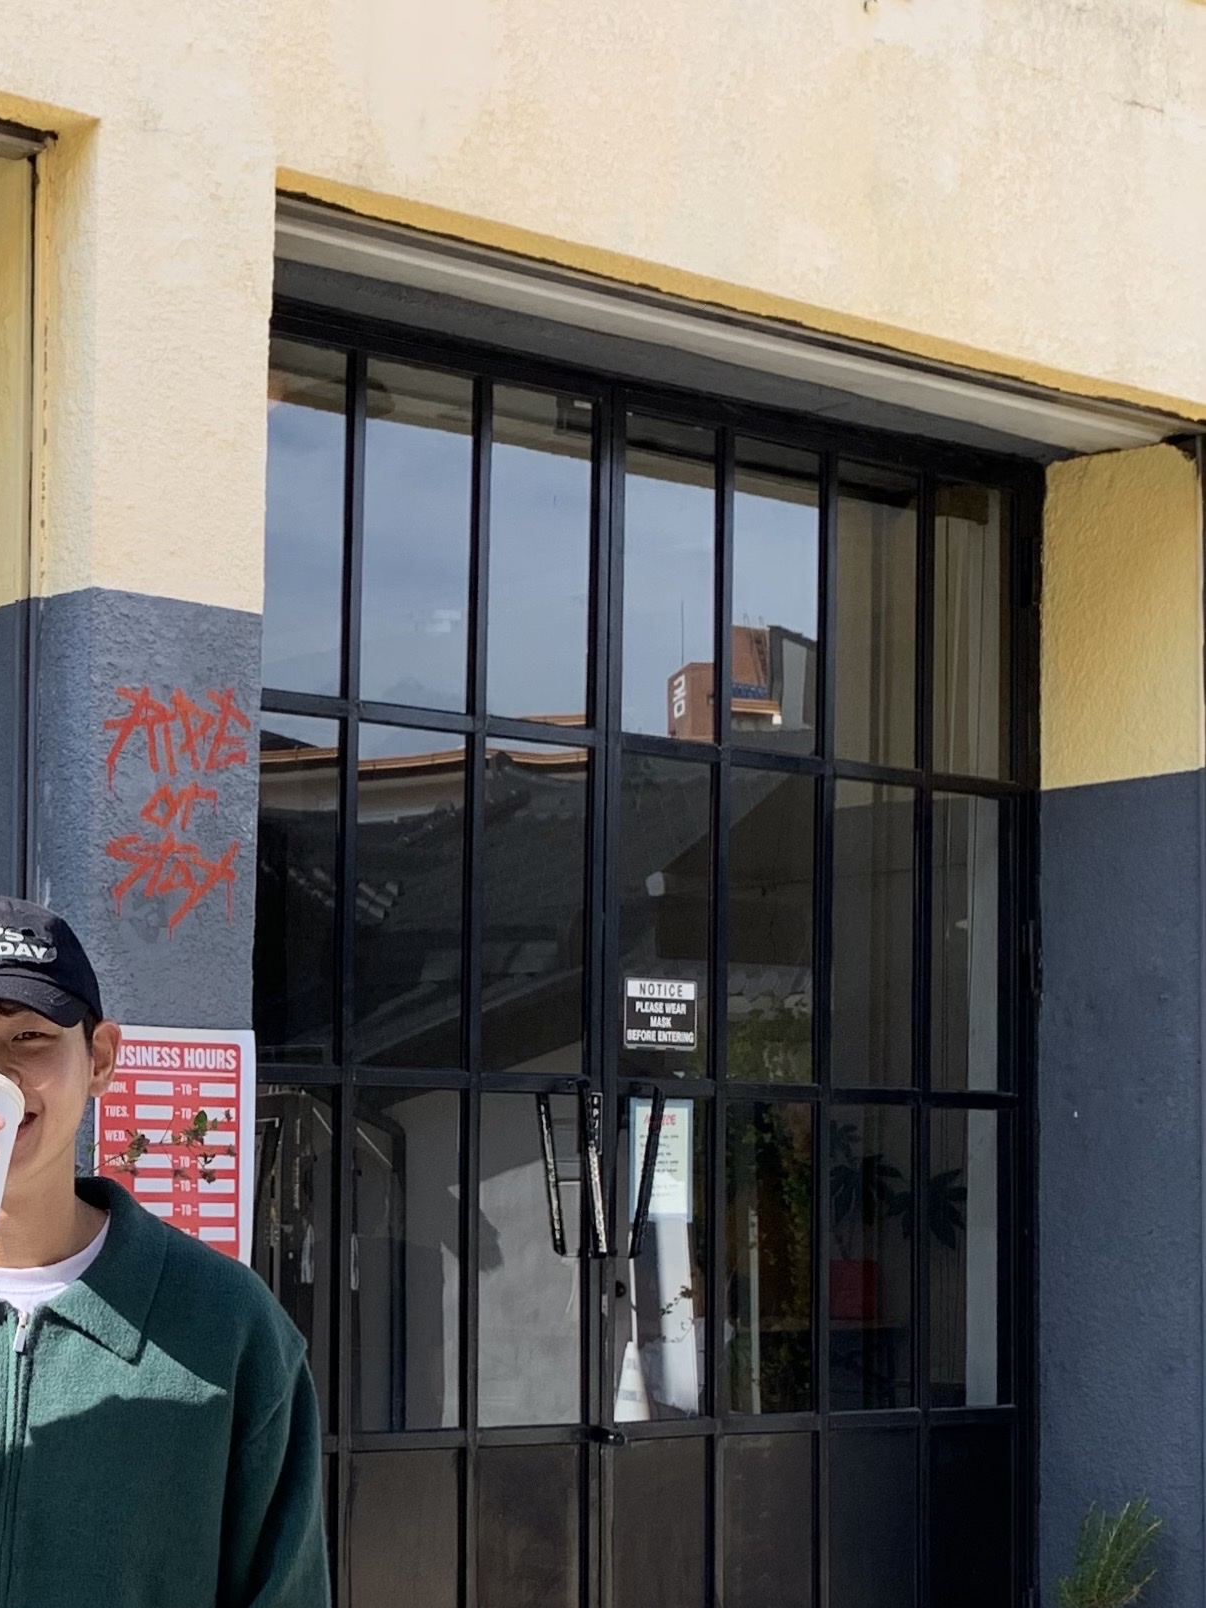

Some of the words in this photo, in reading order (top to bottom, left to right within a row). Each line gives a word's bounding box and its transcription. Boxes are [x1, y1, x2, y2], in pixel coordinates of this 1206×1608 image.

[639, 983, 683, 997] NOTICE
[635, 1001, 664, 1014] PLEASE
[665, 1002, 687, 1015] WEAR
[649, 1016, 672, 1028] MASK
[627, 1029, 657, 1042] BEFORE
[657, 1031, 694, 1043] ENTERING
[117, 1045, 180, 1068] USINESS
[184, 1047, 237, 1070] HOURS
[105, 1105, 129, 1118] TUES.
[105, 1129, 127, 1142] WED.
